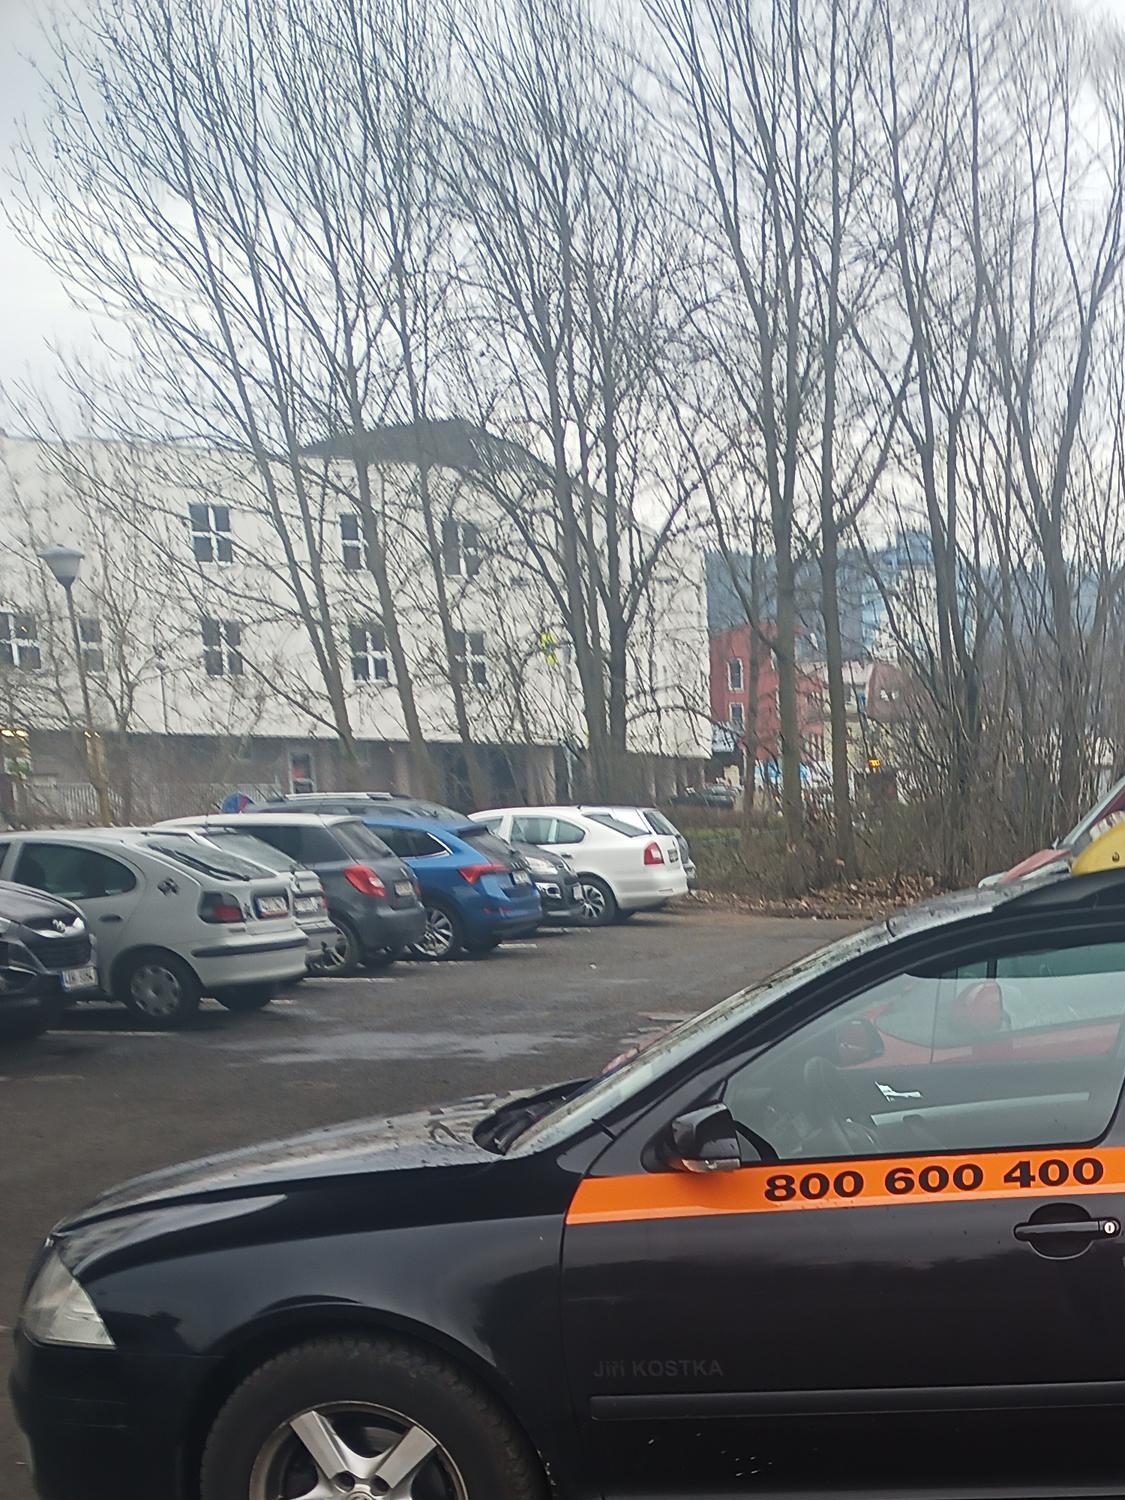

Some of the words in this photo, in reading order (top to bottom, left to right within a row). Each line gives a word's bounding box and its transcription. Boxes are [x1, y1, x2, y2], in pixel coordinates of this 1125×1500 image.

[764, 1171, 864, 1202] 800
[884, 1163, 984, 1195] 600
[1003, 1157, 1104, 1188] 400
[632, 1359, 724, 1377] KOSTKA
